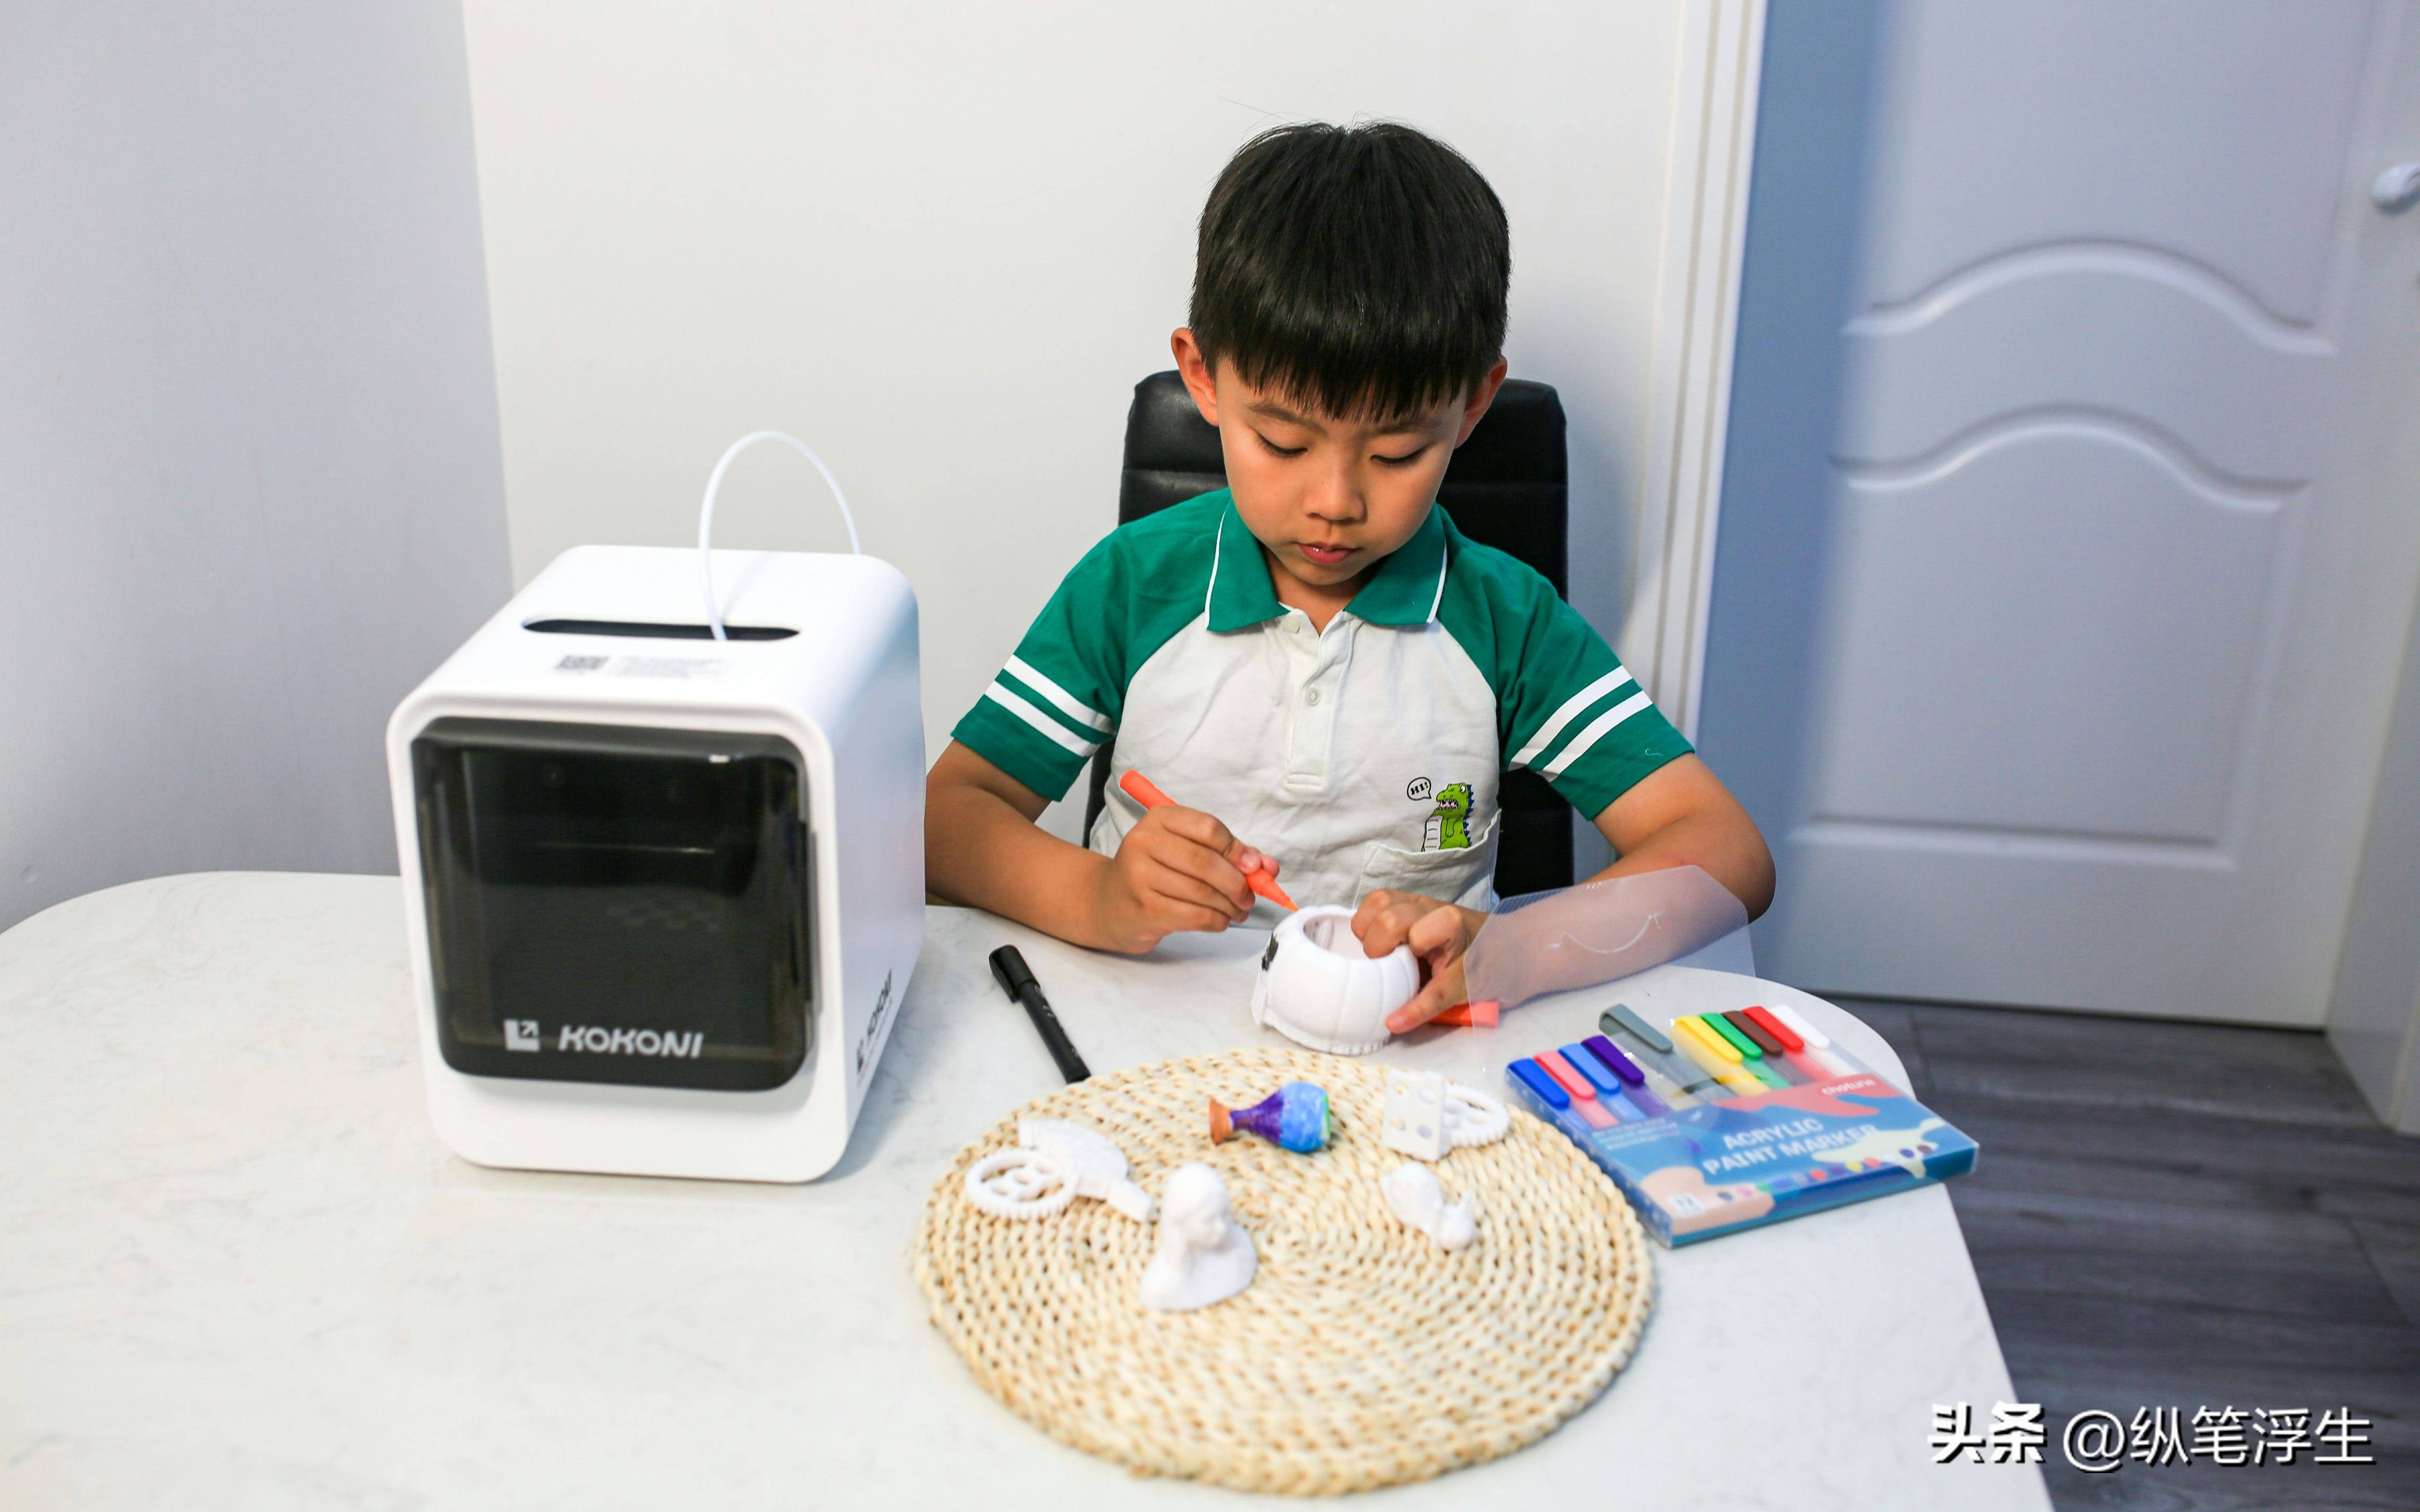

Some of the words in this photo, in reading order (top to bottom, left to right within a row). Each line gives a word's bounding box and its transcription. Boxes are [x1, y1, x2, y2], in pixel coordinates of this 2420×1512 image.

[1410, 781, 1429, 795] HI!
[557, 1024, 704, 1059] KOKONI
[1723, 1118, 1824, 1150] ACRYLIC
[1702, 1145, 1778, 1175] PAINT
